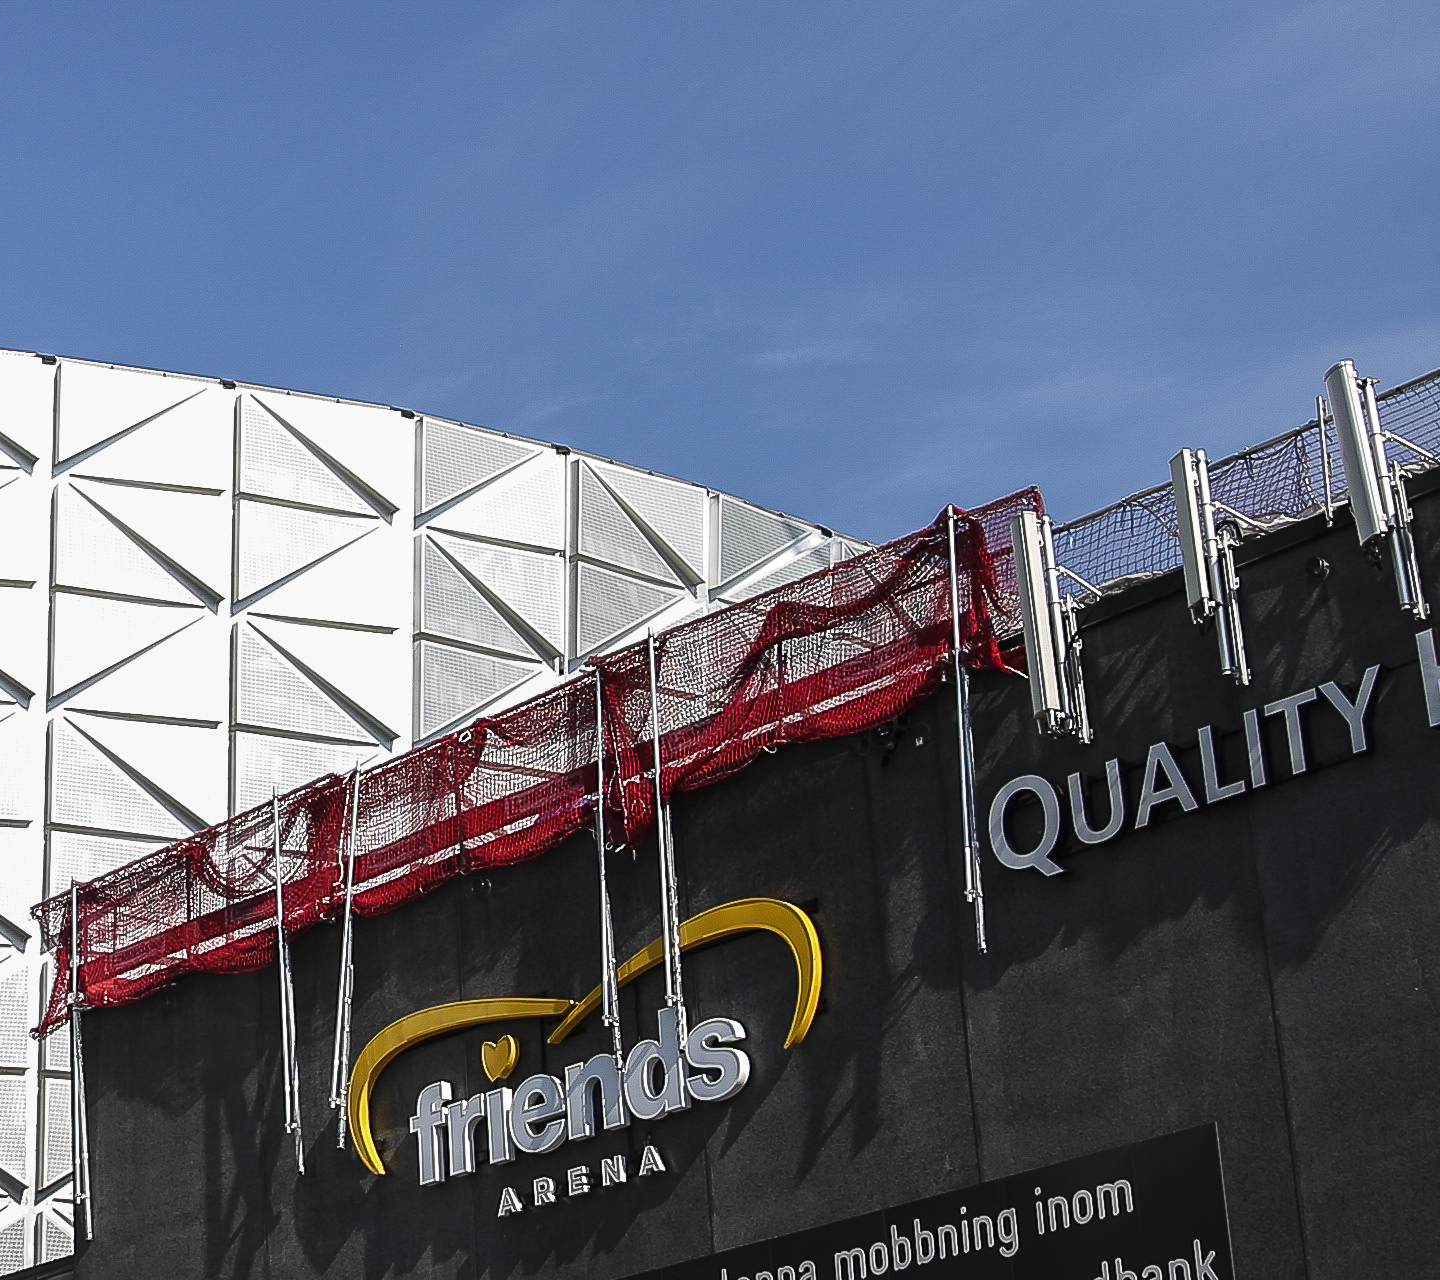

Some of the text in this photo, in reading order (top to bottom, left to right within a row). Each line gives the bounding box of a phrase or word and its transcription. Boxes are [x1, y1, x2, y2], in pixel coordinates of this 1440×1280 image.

[988, 663, 1382, 877] QUALITY
[409, 1007, 751, 1186] friends
[497, 1144, 666, 1217] ARENA
[1034, 1178, 1134, 1235] inom
